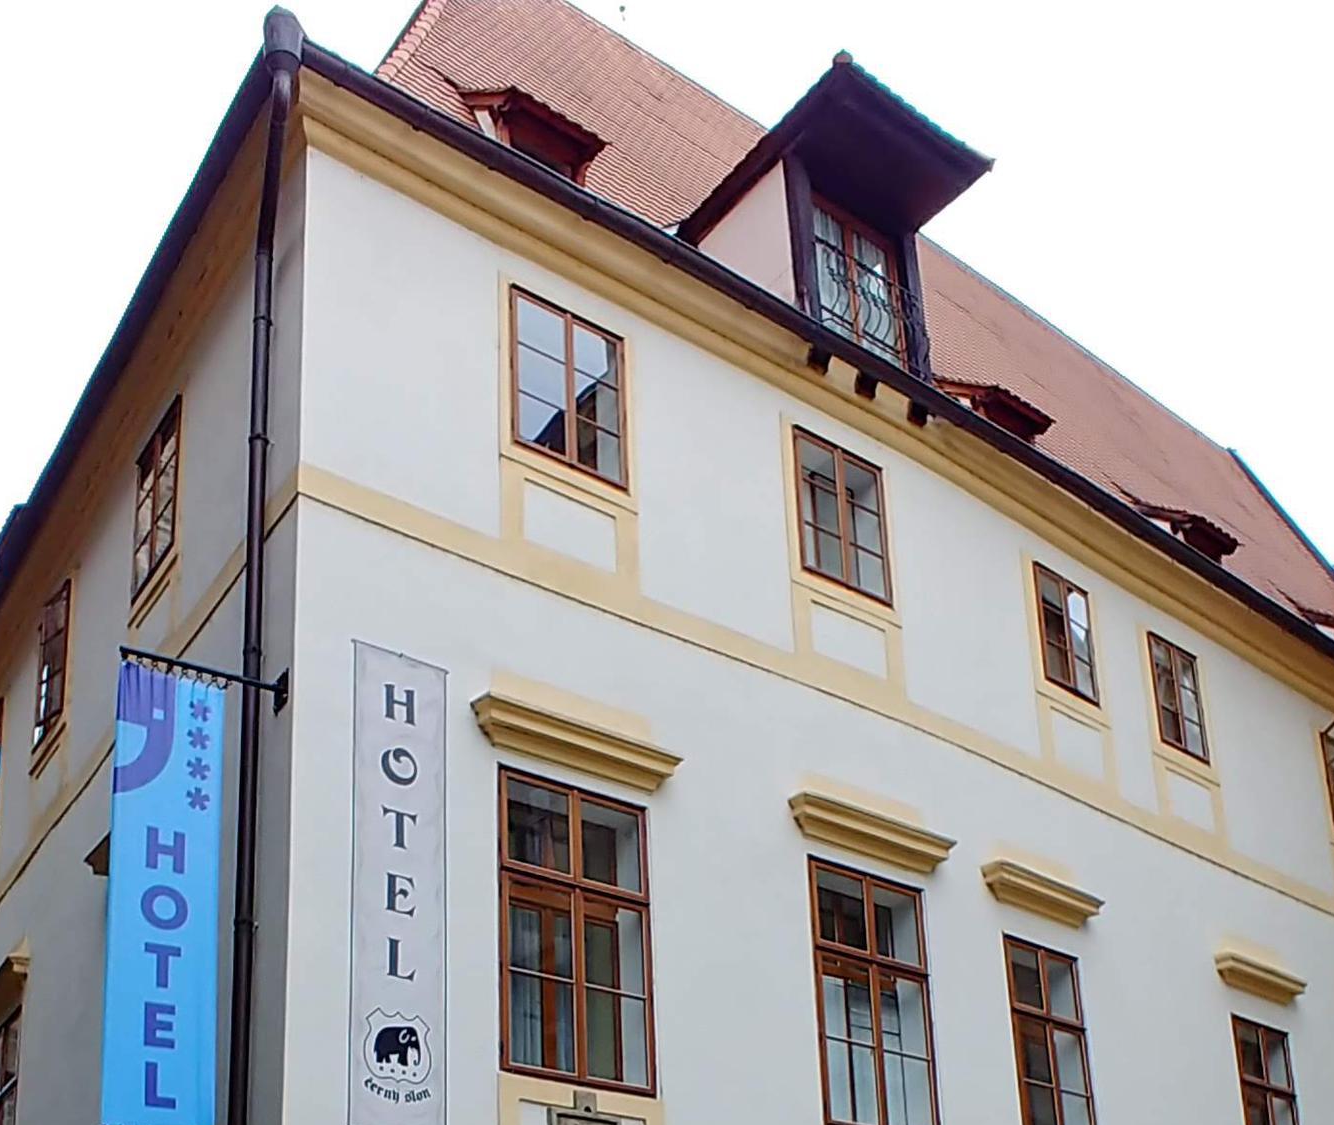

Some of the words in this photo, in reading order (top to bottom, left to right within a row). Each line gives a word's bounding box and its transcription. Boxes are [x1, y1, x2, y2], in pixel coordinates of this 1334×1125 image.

[140, 826, 189, 1110] HOTEL
[380, 683, 418, 982] HOTEL
[405, 1087, 431, 1103] slon
